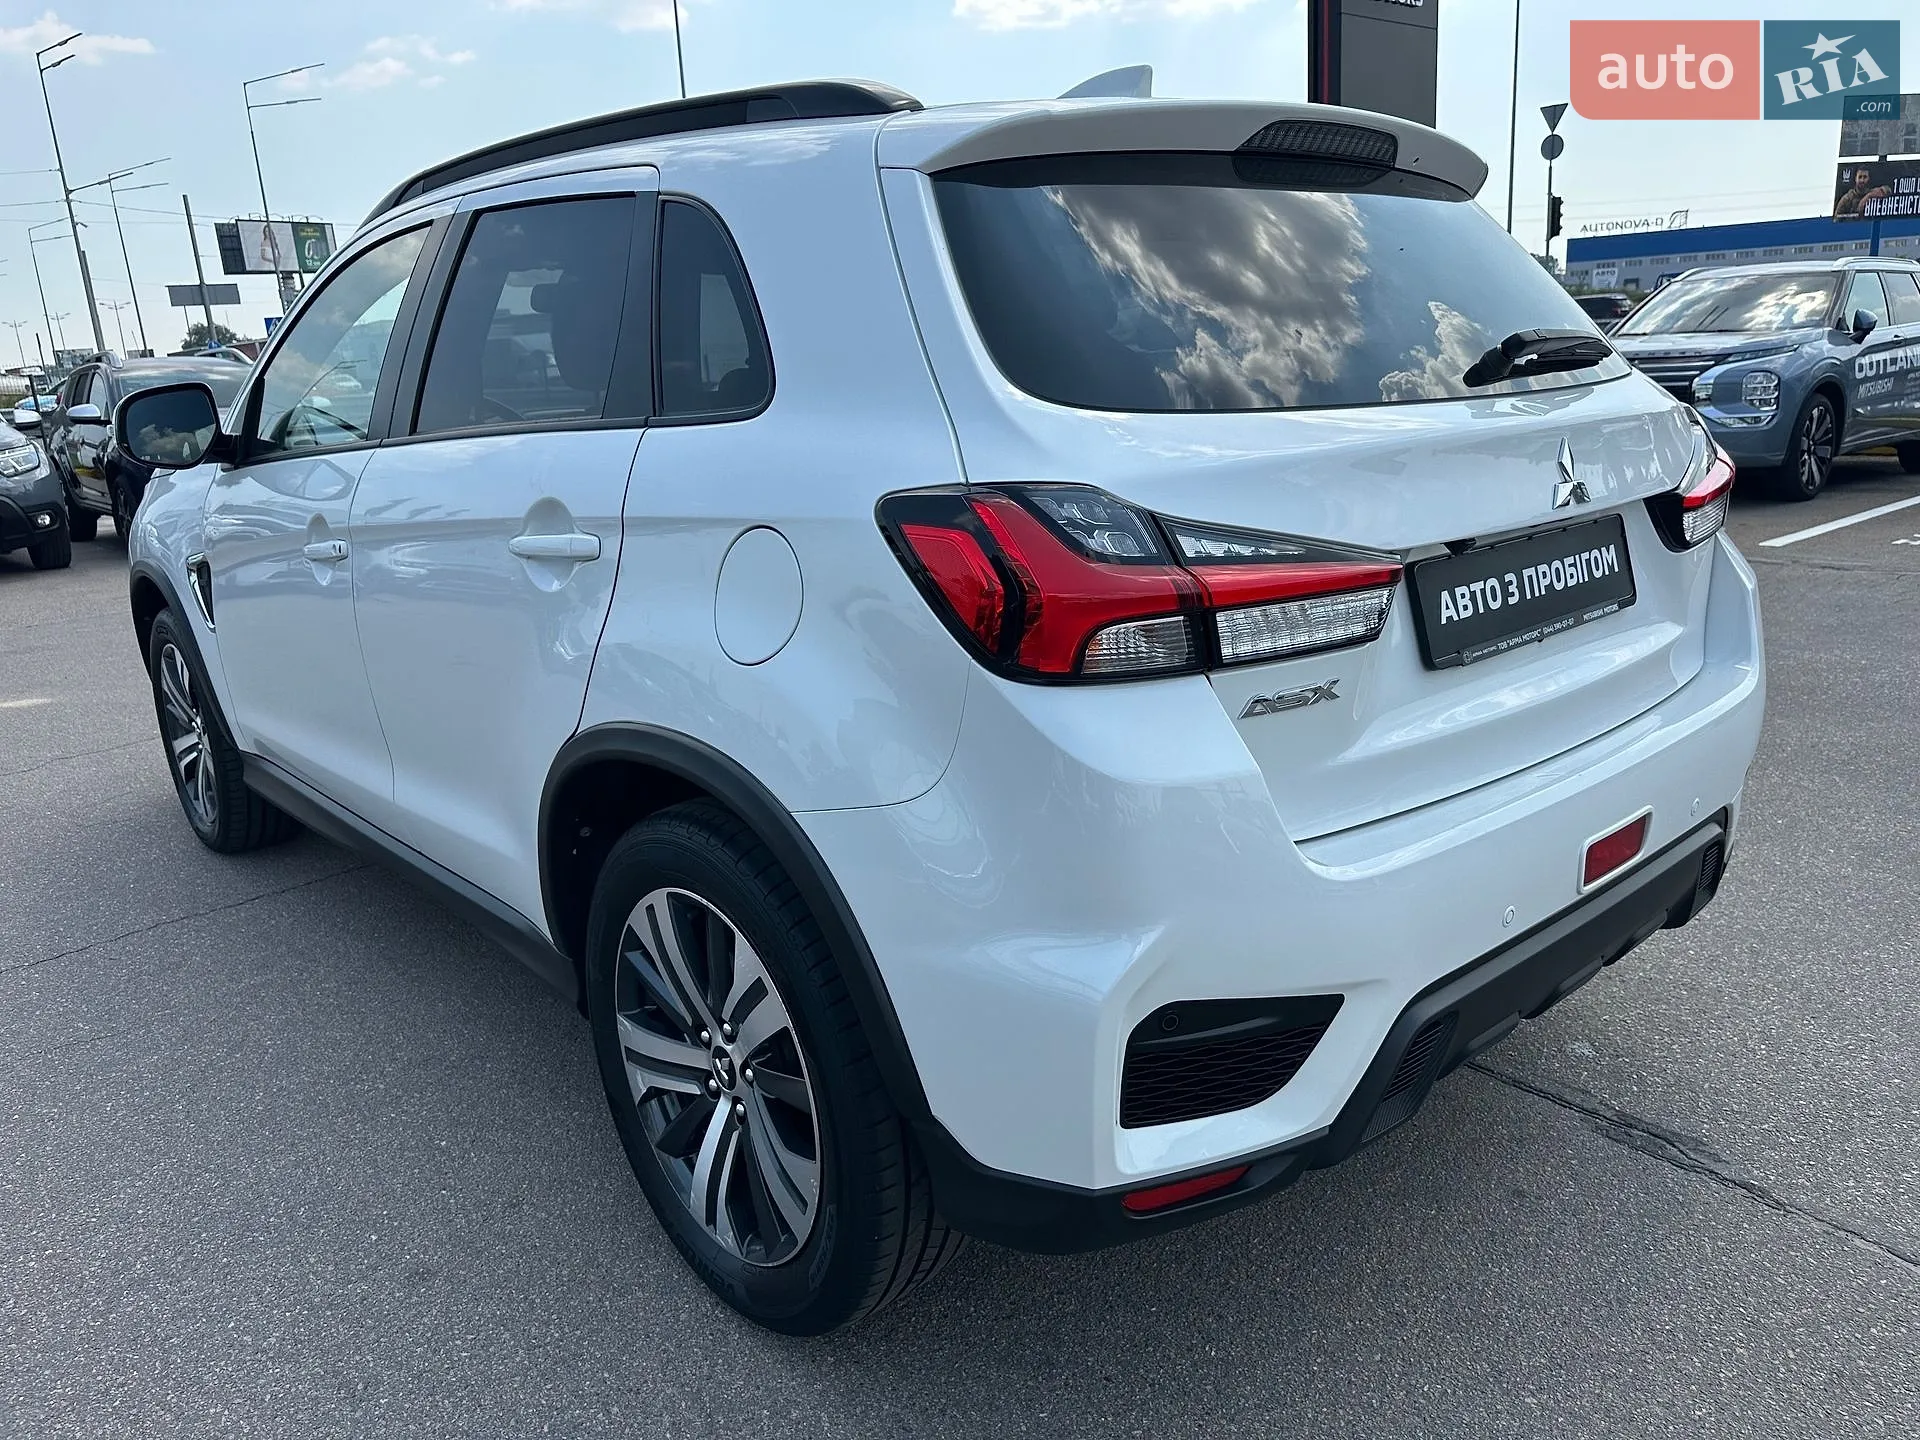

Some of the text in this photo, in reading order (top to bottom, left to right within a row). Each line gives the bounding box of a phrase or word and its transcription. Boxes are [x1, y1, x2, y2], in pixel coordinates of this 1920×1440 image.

[1855, 345, 1920, 379] OUTLAN
[1440, 577, 1502, 624] АВТО
[1522, 544, 1619, 600] ПРОБІГОМ
[1238, 678, 1341, 719] ASX
